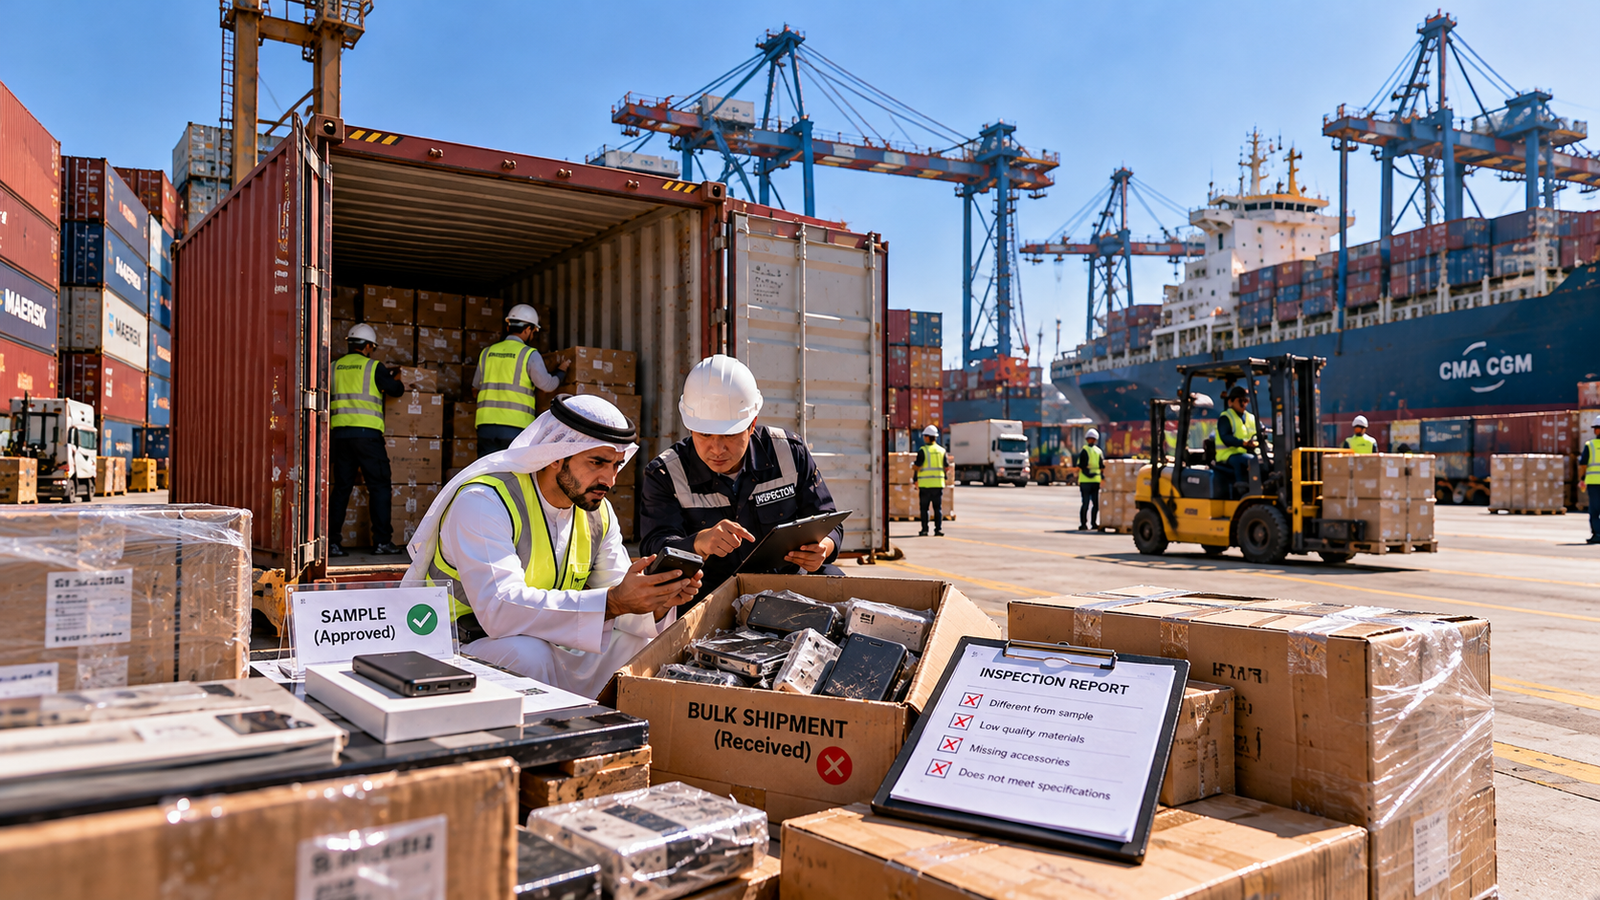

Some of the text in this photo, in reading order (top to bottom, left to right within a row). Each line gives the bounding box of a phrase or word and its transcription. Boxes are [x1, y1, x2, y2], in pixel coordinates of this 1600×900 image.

[4, 288, 47, 329] MAERSK
[1439, 353, 1532, 380] CMA CGM
[321, 607, 387, 623] SAMPLE
[314, 625, 396, 646] (Approved)
[979, 667, 1129, 695] INSPECTION REPORT
[687, 701, 848, 739] BULK SHIPMENT
[989, 699, 1094, 721] Different from sample
[714, 729, 811, 763] (Received)
[979, 721, 1085, 744] Low quality materials
[969, 744, 1071, 767] Missing accessories
[958, 767, 1111, 801] Does not meet specifications
